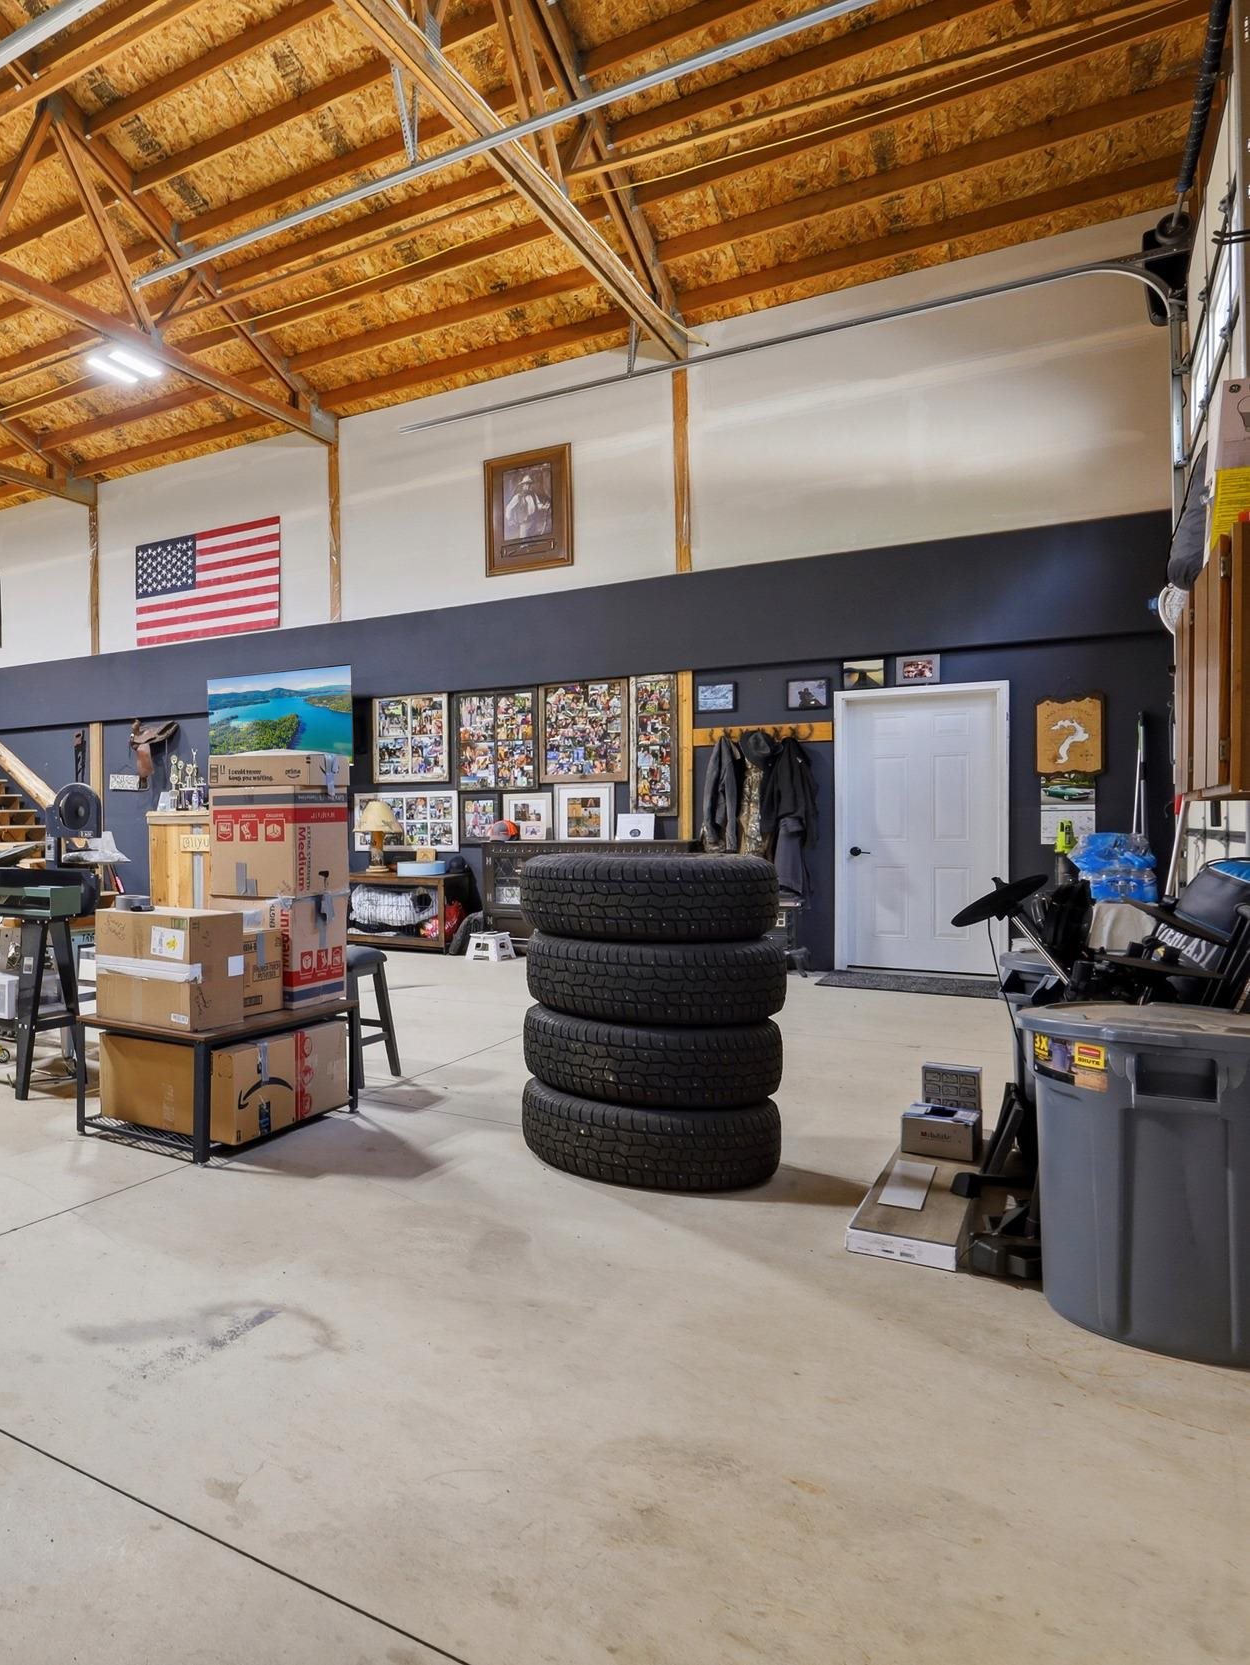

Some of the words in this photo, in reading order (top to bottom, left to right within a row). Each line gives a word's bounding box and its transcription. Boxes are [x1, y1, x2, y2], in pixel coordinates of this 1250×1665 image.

[284, 768, 302, 776] prime
[298, 827, 307, 892] Medium
[1035, 1032, 1048, 1050] 3X
[1077, 1056, 1100, 1066] BRUTE
